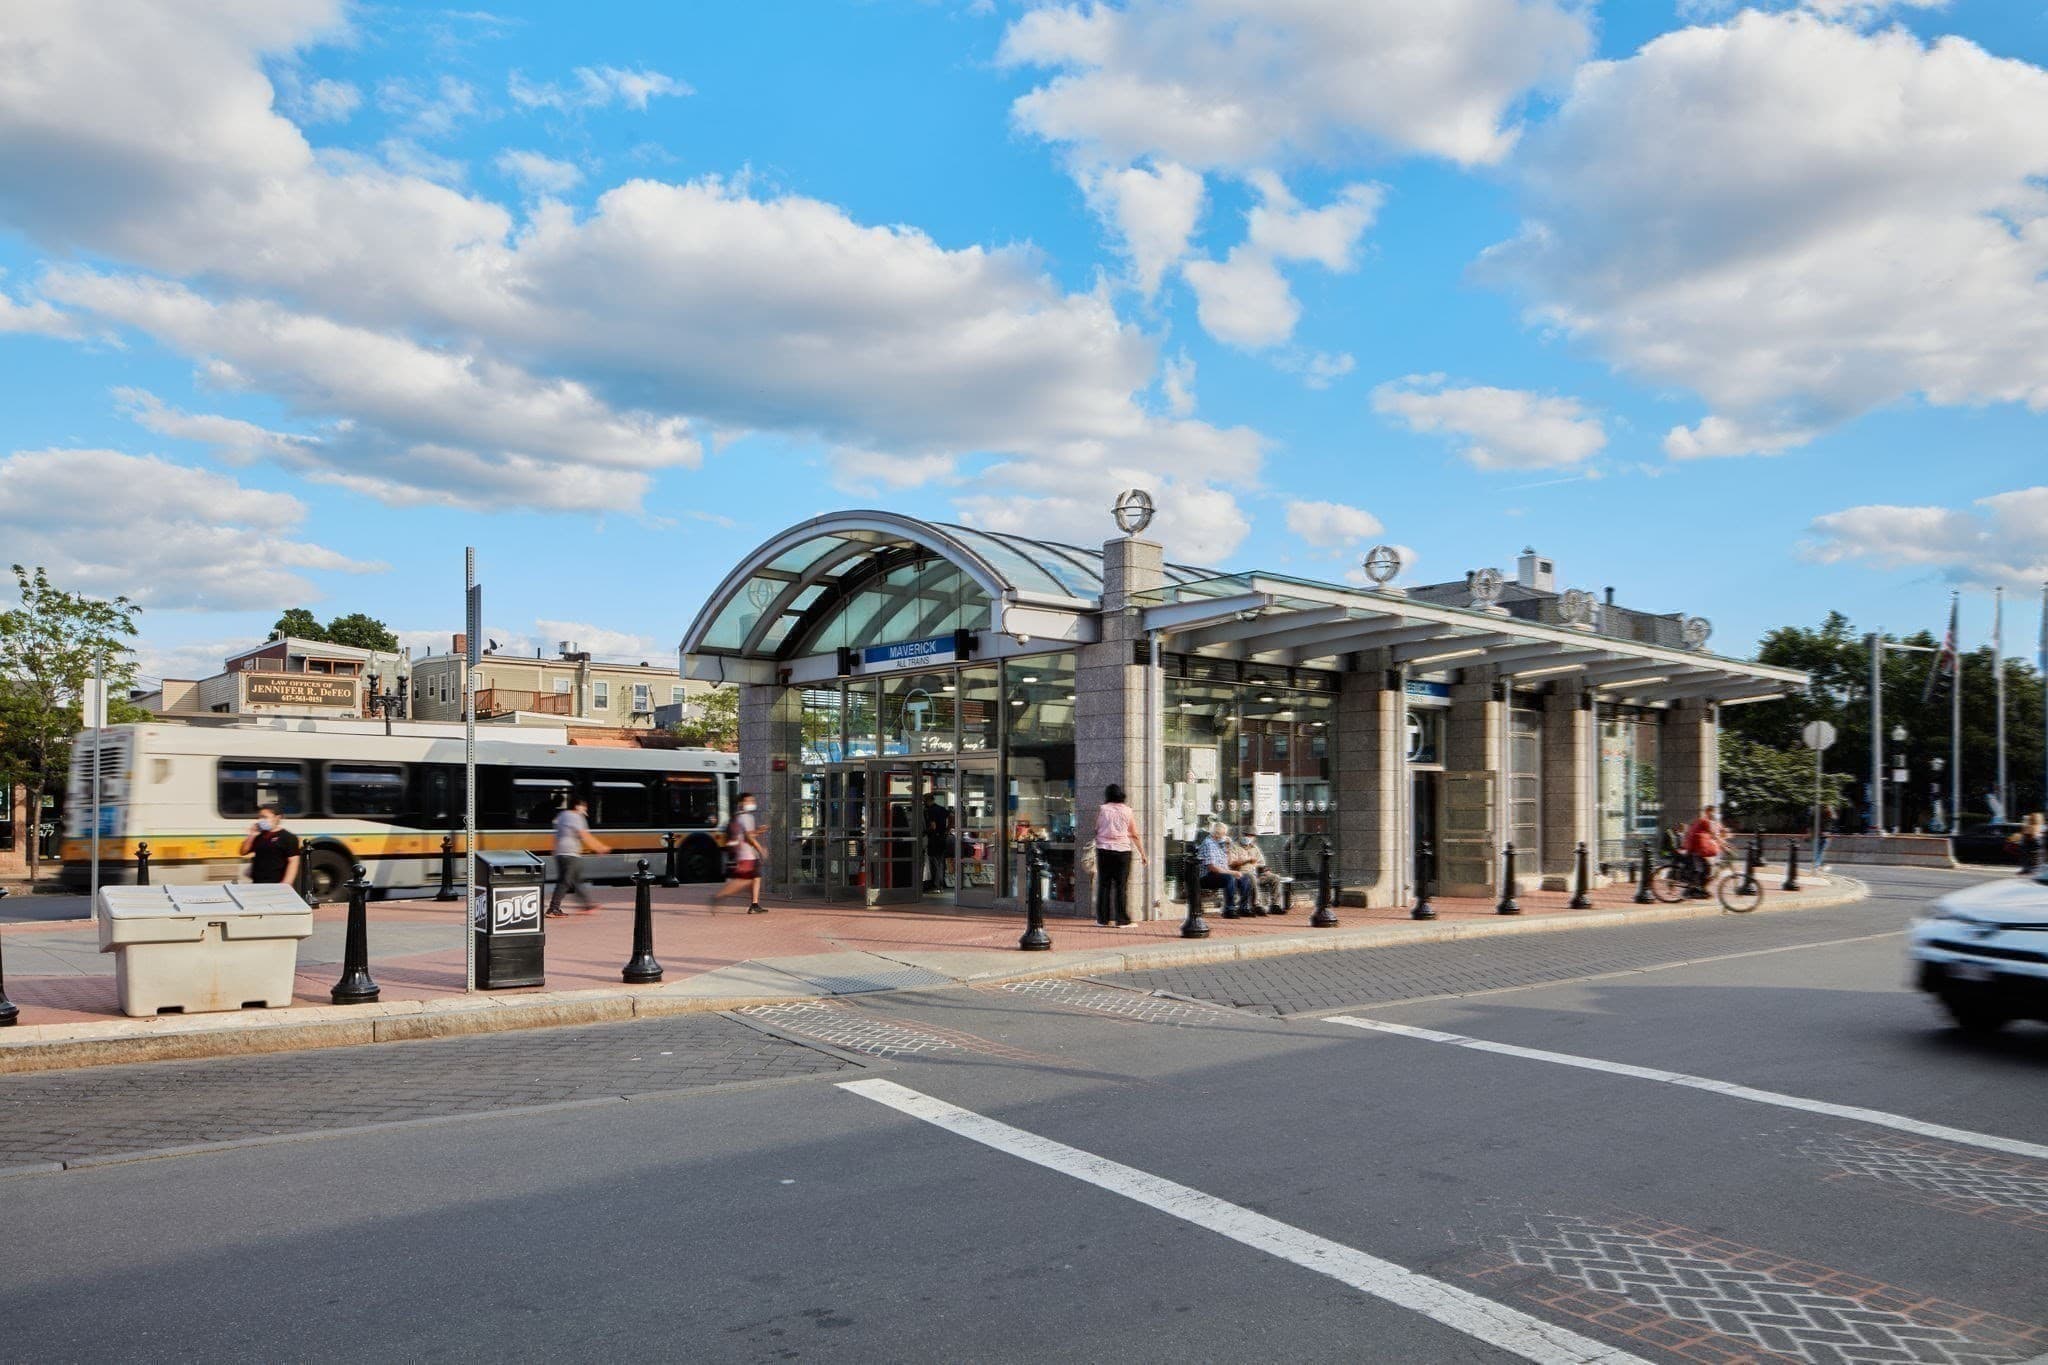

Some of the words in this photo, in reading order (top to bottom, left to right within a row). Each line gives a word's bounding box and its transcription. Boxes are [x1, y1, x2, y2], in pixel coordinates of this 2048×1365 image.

[889, 640, 936, 659] MAVERICK
[896, 659, 908, 668] ALL
[908, 656, 930, 667] TRAINS
[252, 684, 304, 695] JENNIFER
[307, 687, 317, 696] R.
[320, 688, 352, 697] DeFEO
[496, 893, 537, 924] DIG
